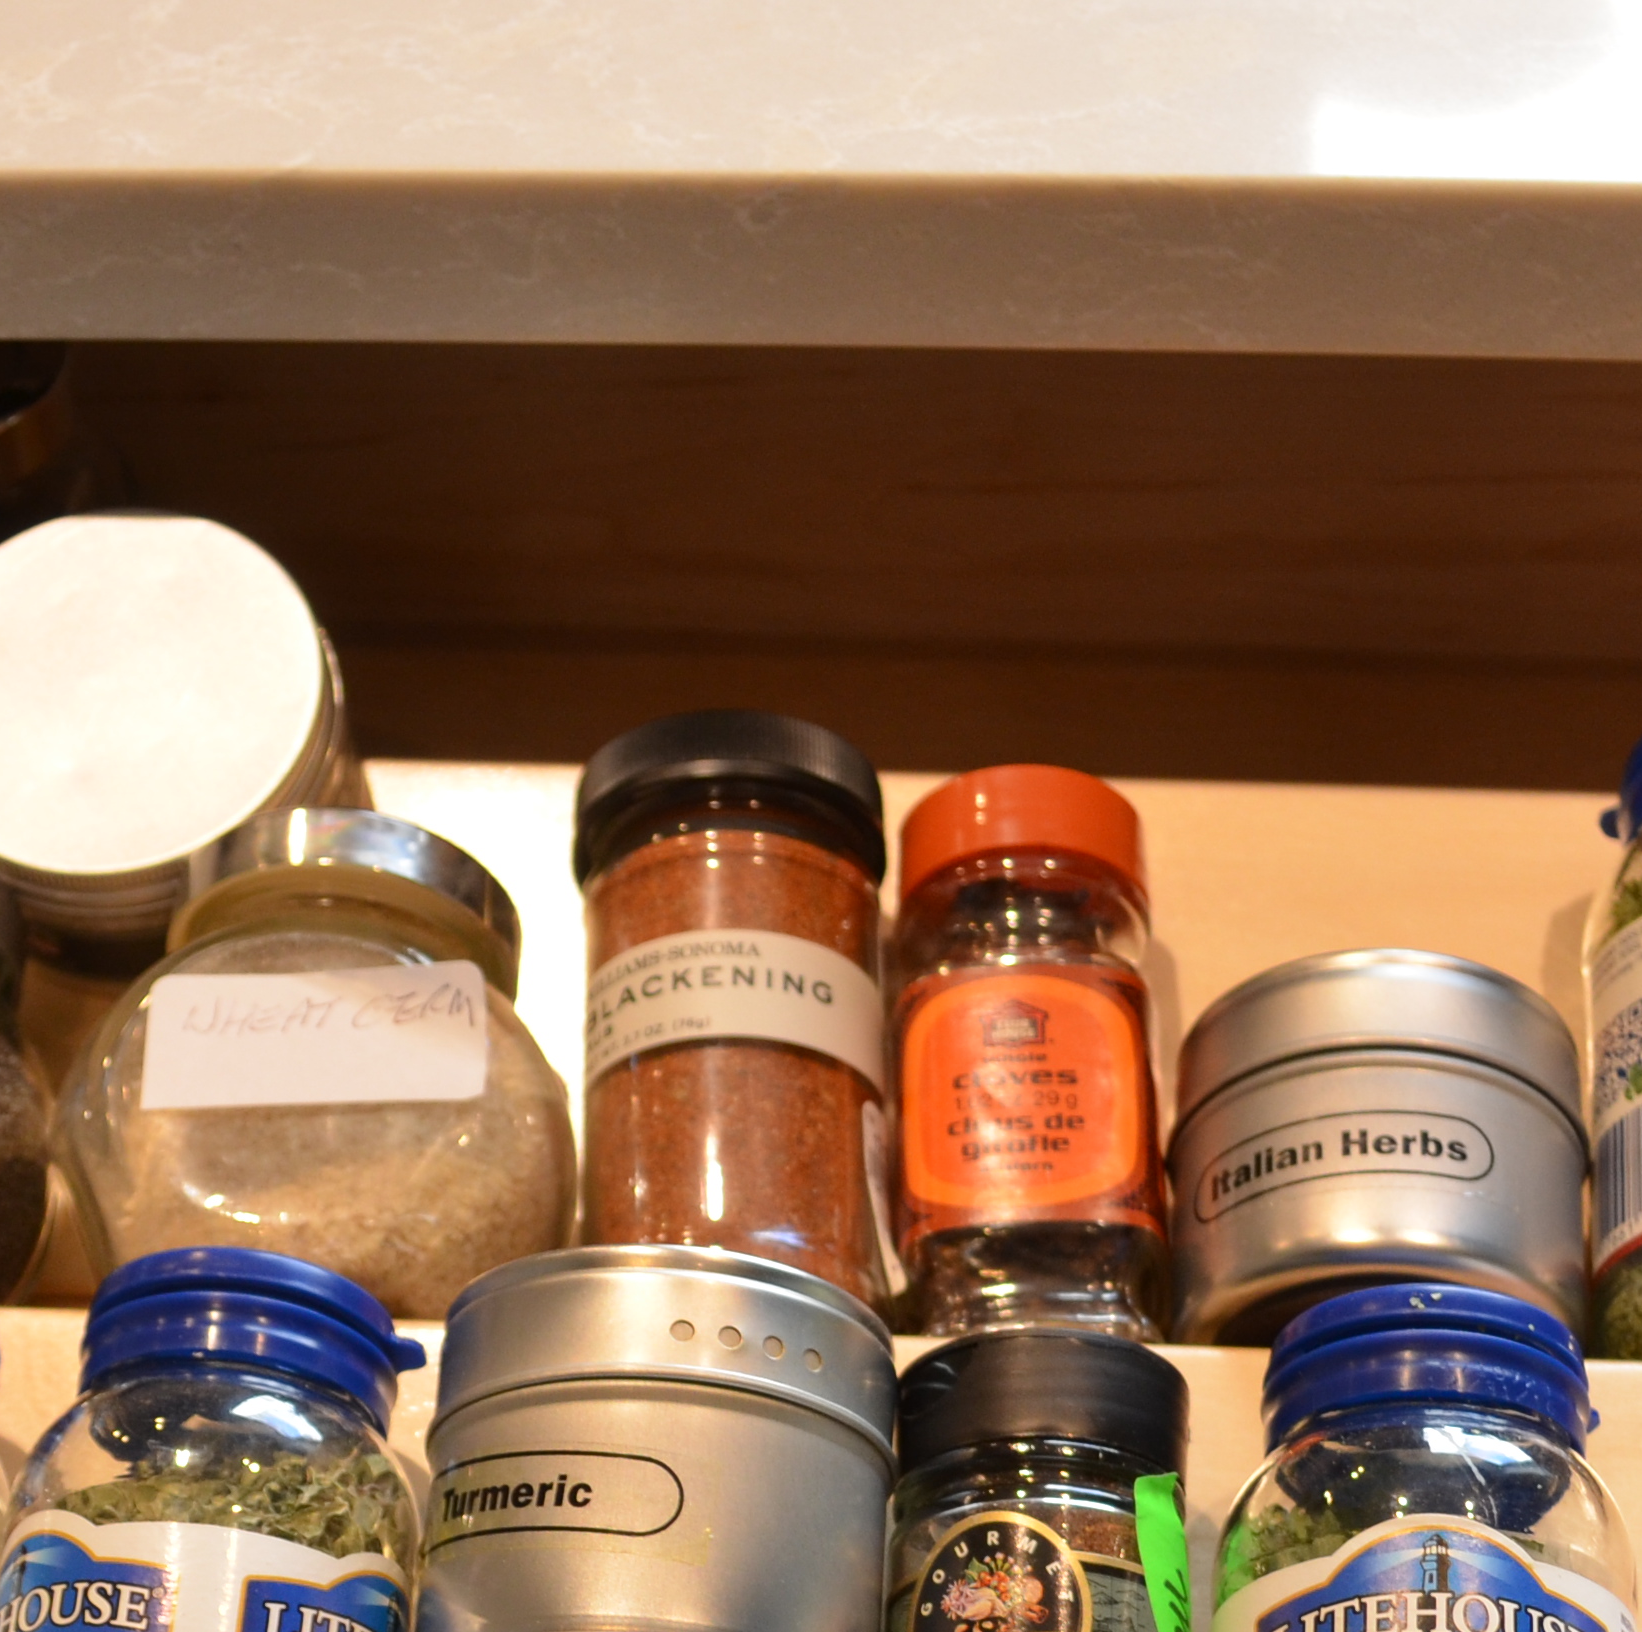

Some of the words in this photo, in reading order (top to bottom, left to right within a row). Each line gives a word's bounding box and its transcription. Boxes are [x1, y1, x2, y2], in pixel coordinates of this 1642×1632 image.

[1044, 1112, 1085, 1130] de
[1211, 1137, 1323, 1200] Italian
[1341, 1128, 1469, 1163] Herbs
[442, 1474, 595, 1522] Turmeric
[920, 1530, 1075, 1617] GOURMET
